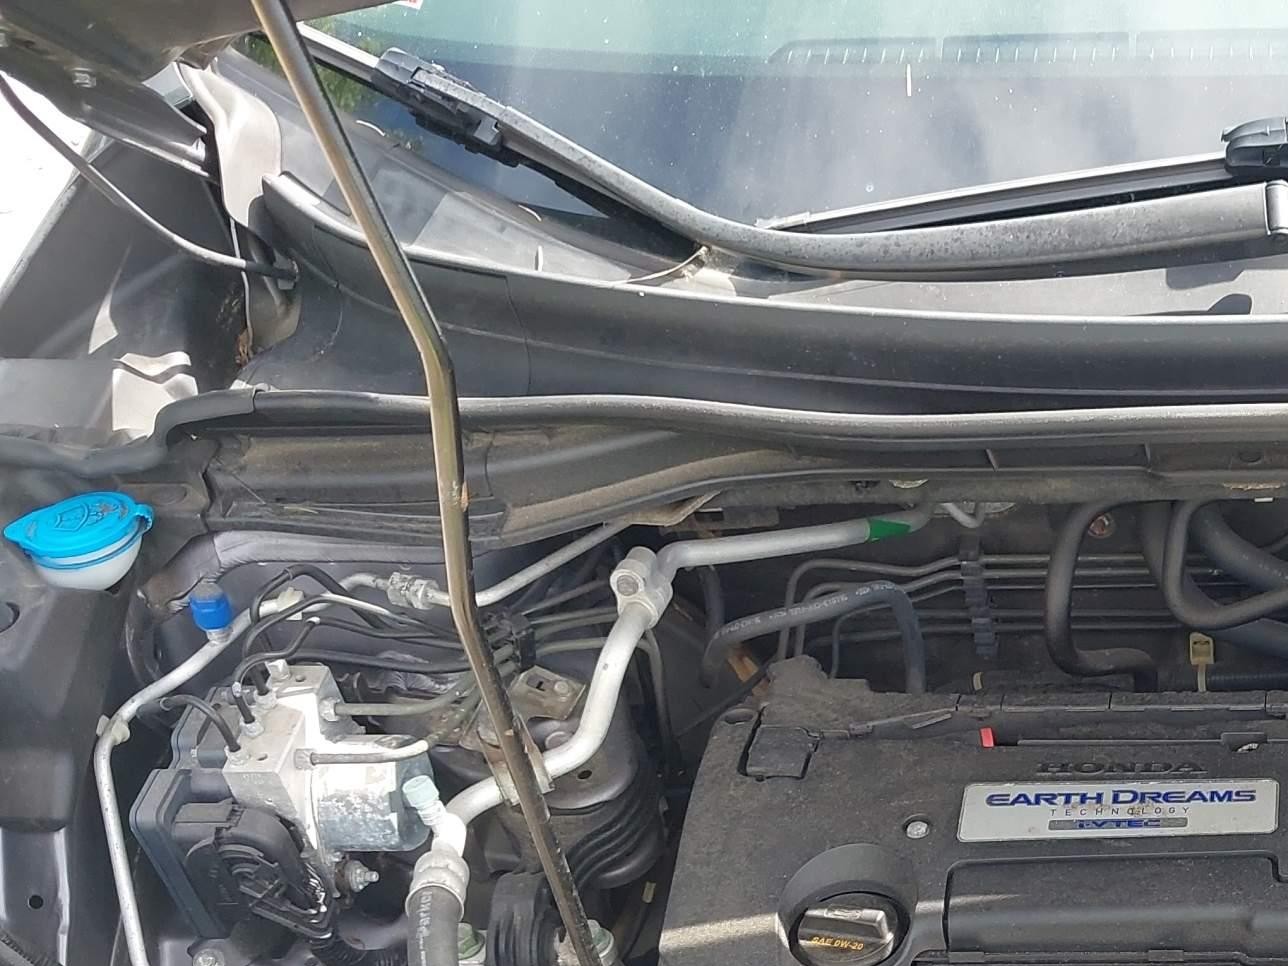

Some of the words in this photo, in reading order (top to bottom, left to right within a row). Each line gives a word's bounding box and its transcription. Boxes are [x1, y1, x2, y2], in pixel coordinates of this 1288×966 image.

[1036, 761, 1208, 775] HONDA
[985, 792, 1104, 807] EARTH
[1050, 807, 1190, 816] TECHNOLOGY
[812, 936, 833, 945] SAE
[834, 941, 864, 950] 0W-20
